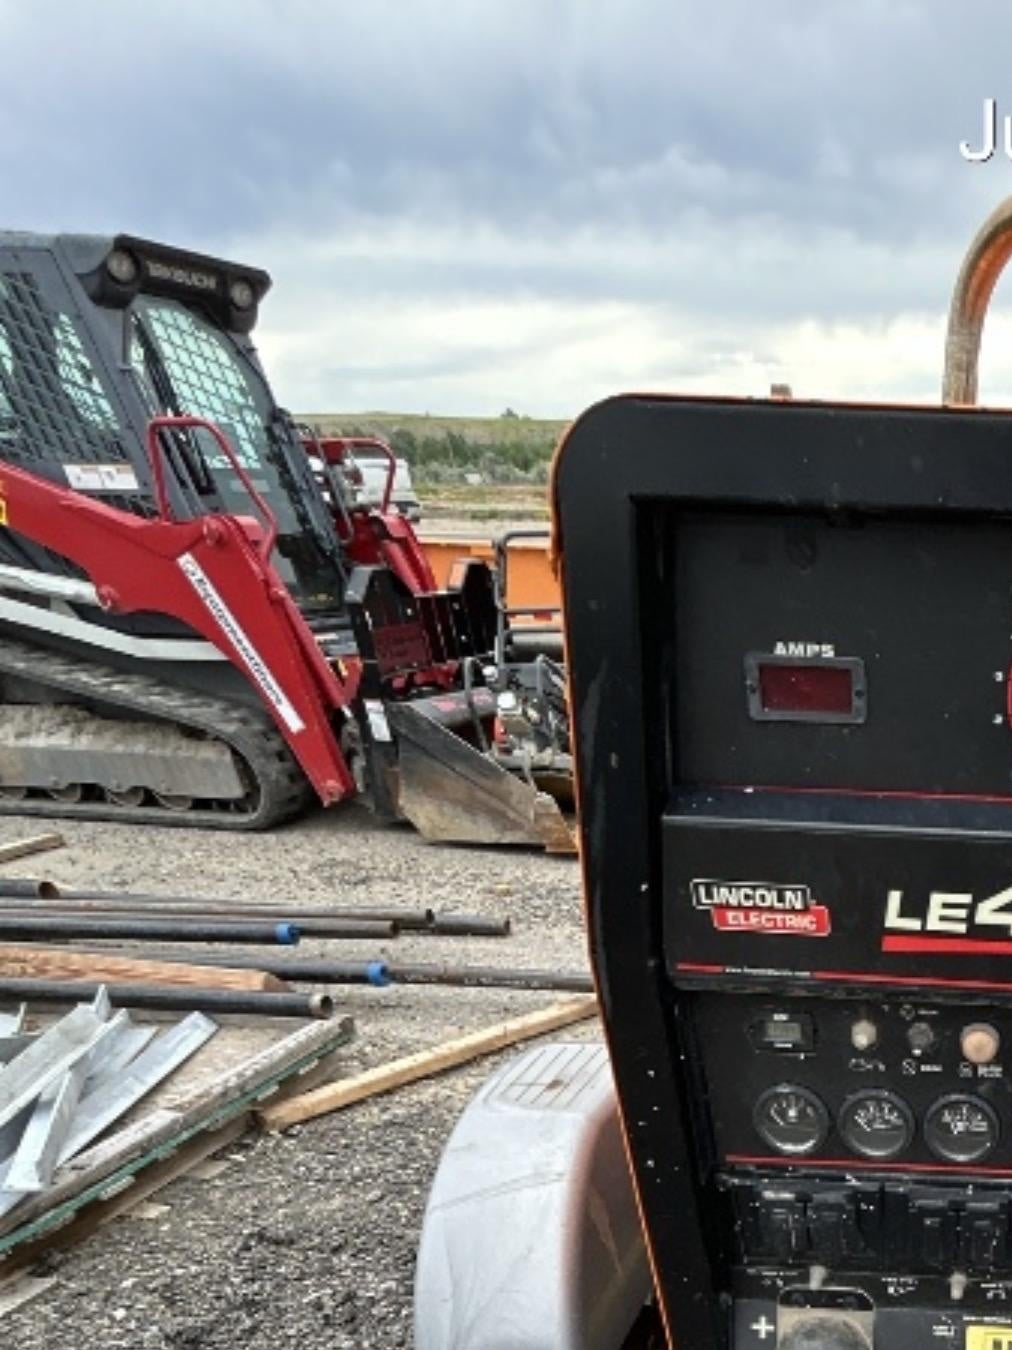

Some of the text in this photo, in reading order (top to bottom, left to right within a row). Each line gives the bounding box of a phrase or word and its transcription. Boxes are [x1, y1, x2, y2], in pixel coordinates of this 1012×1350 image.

[773, 641, 835, 658] AMPS
[697, 884, 806, 910] LINCOLN
[724, 910, 818, 931] ELECTRIC
